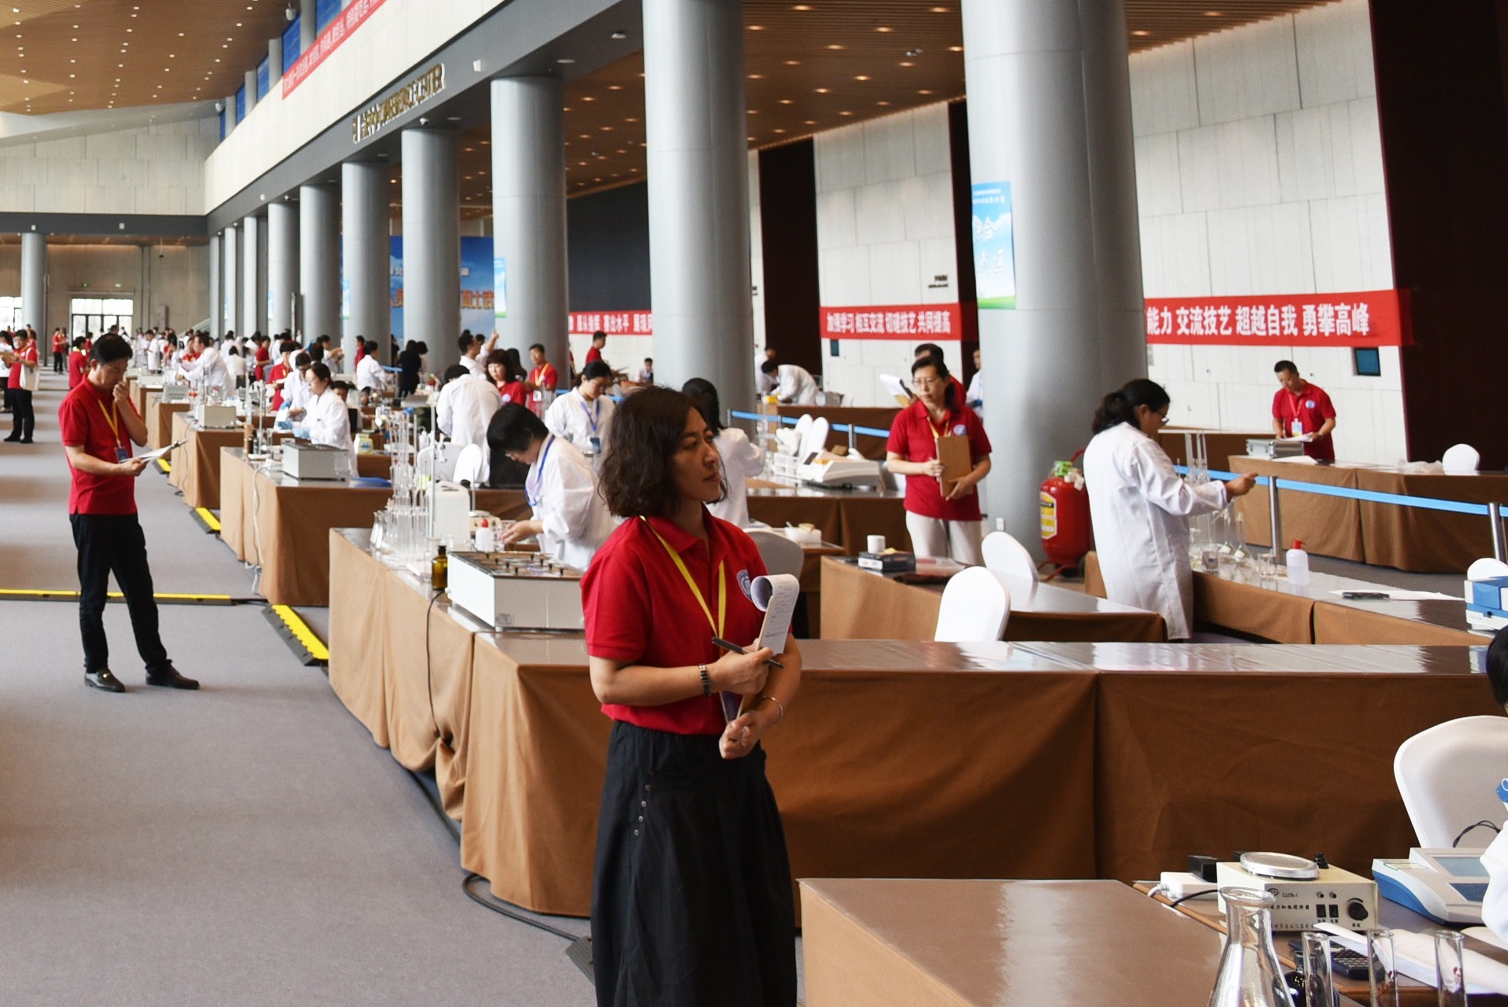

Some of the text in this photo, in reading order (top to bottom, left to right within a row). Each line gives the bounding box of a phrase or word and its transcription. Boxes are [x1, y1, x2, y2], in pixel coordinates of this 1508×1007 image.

[1176, 305, 1233, 336] 交流技艺
[1235, 305, 1298, 337] 超越自我
[1302, 302, 1370, 337] 勇攀高峰
